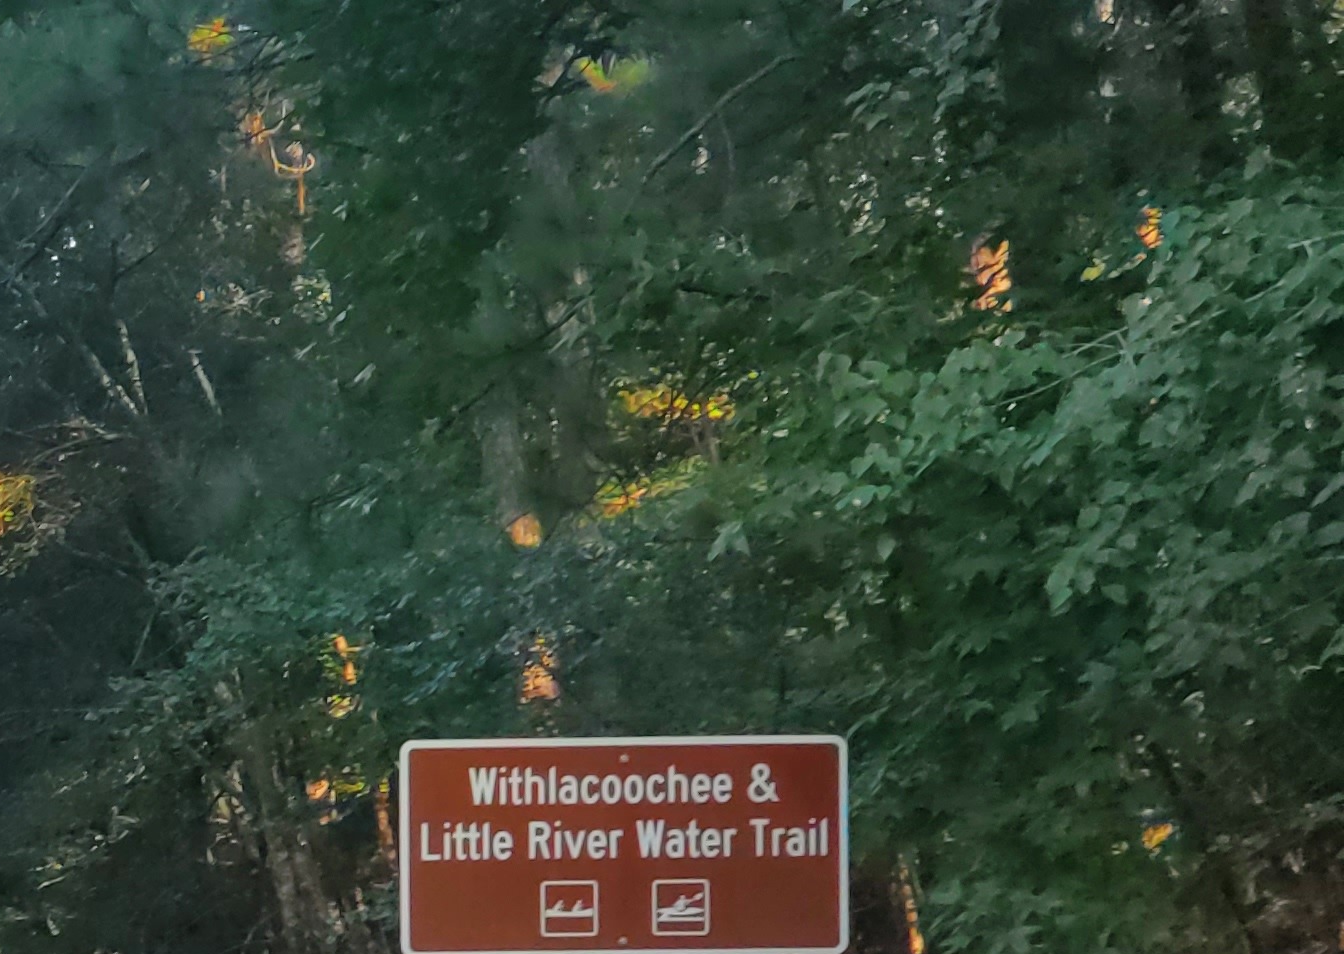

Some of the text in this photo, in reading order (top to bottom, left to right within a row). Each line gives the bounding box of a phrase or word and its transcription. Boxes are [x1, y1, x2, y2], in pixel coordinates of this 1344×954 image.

[468, 763, 779, 805] Withlacoochee &
[420, 817, 828, 862] Little River Water Trail
